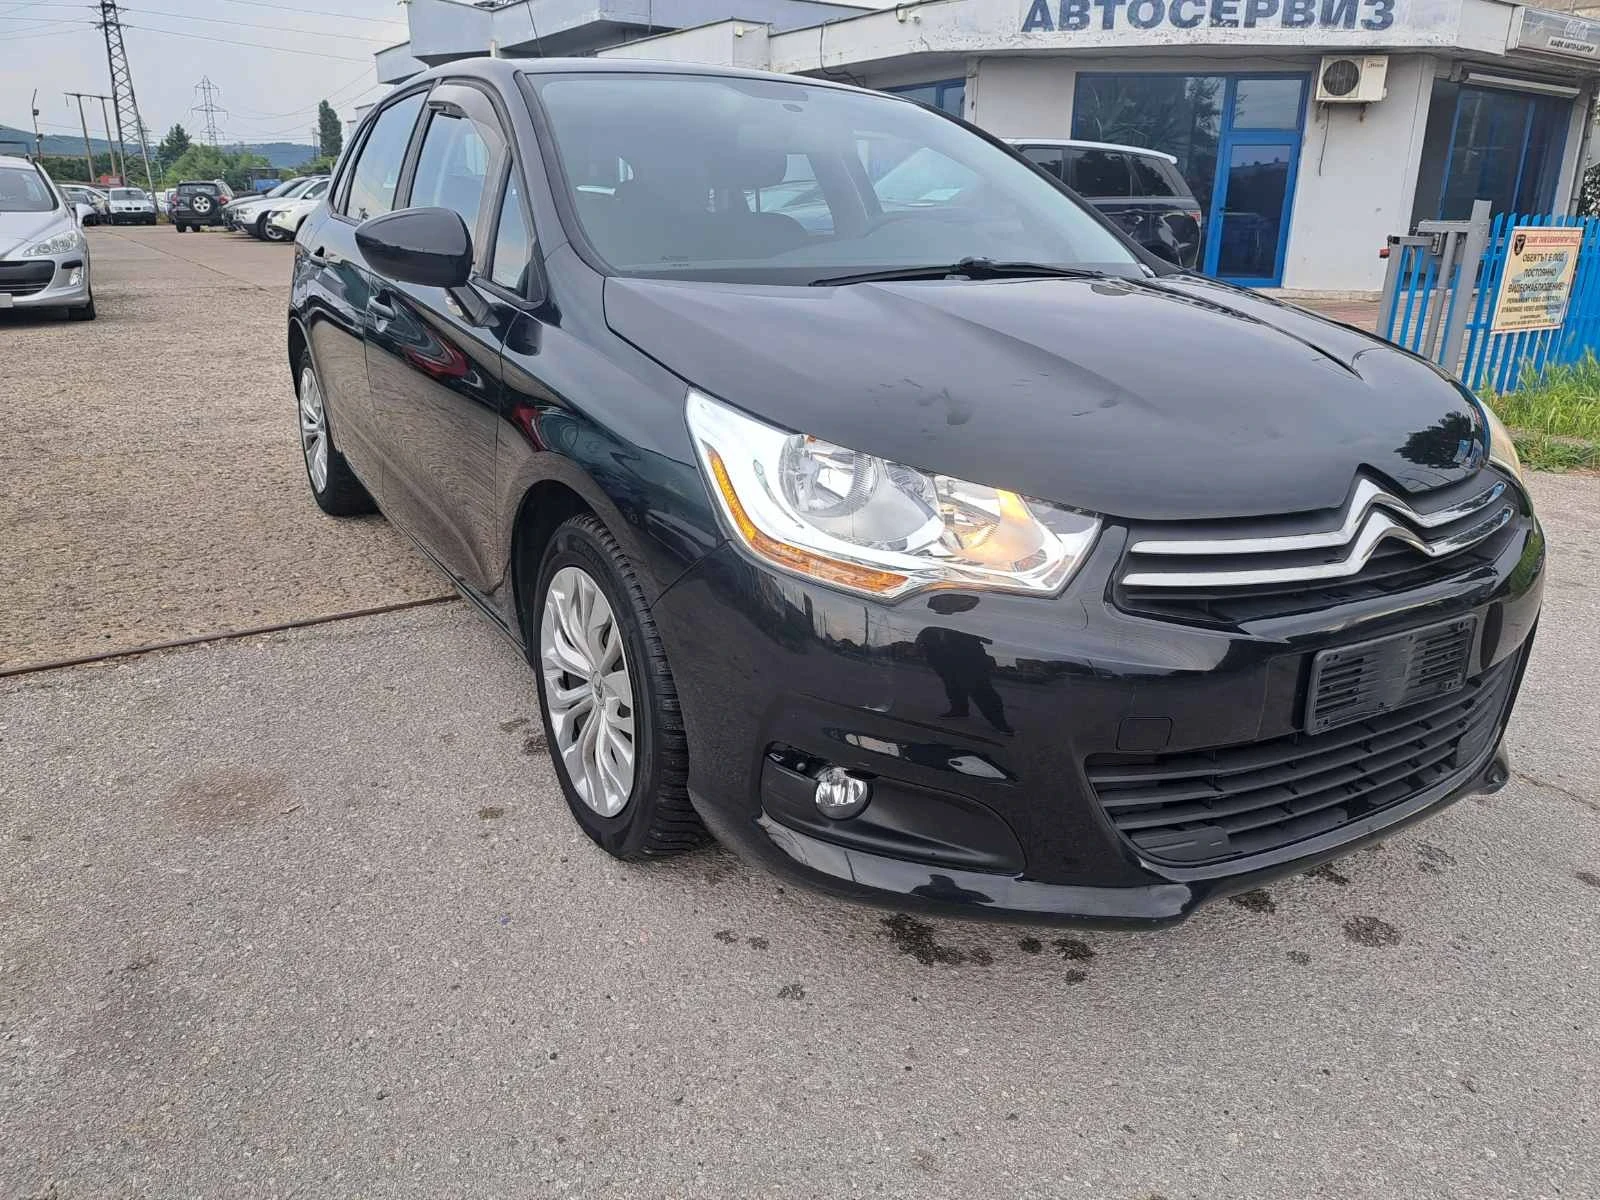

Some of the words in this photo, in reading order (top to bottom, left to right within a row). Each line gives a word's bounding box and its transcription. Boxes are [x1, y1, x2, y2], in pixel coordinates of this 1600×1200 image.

[1021, 0, 1394, 32] АВТОСЕРВИЗ
[1523, 253, 1548, 262] ОБЕКТЪТ
[1524, 267, 1557, 278] ПОСТОЯННО
